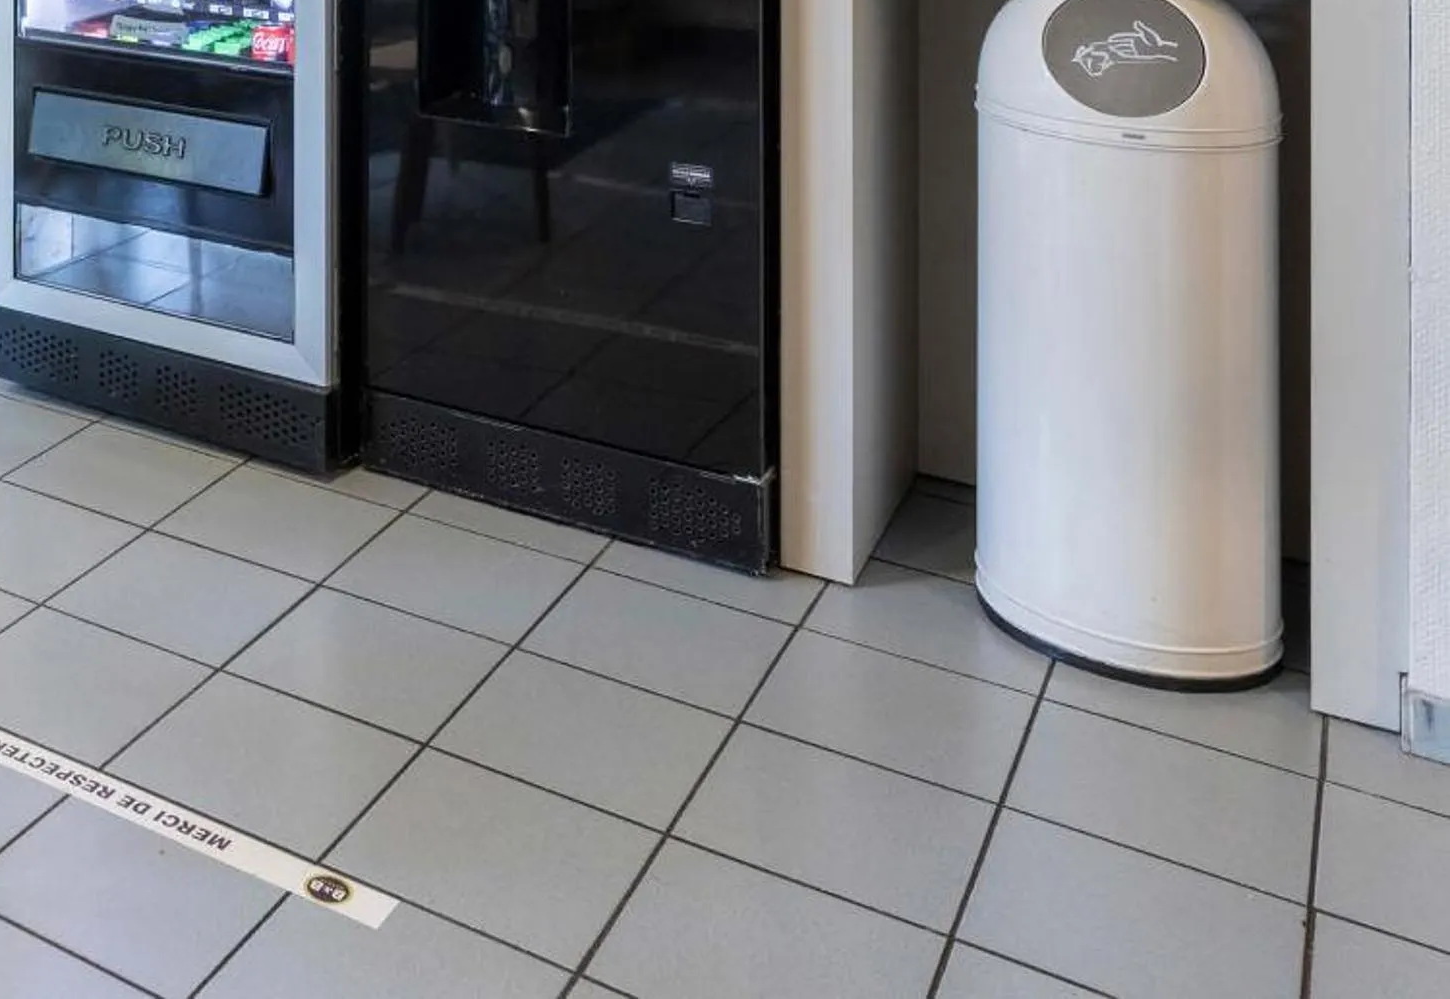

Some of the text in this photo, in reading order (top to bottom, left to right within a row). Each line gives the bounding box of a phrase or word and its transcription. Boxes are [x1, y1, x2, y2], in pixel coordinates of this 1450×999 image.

[101, 125, 187, 159] PUSH
[116, 794, 151, 816] DE
[153, 810, 232, 851] MERCI
